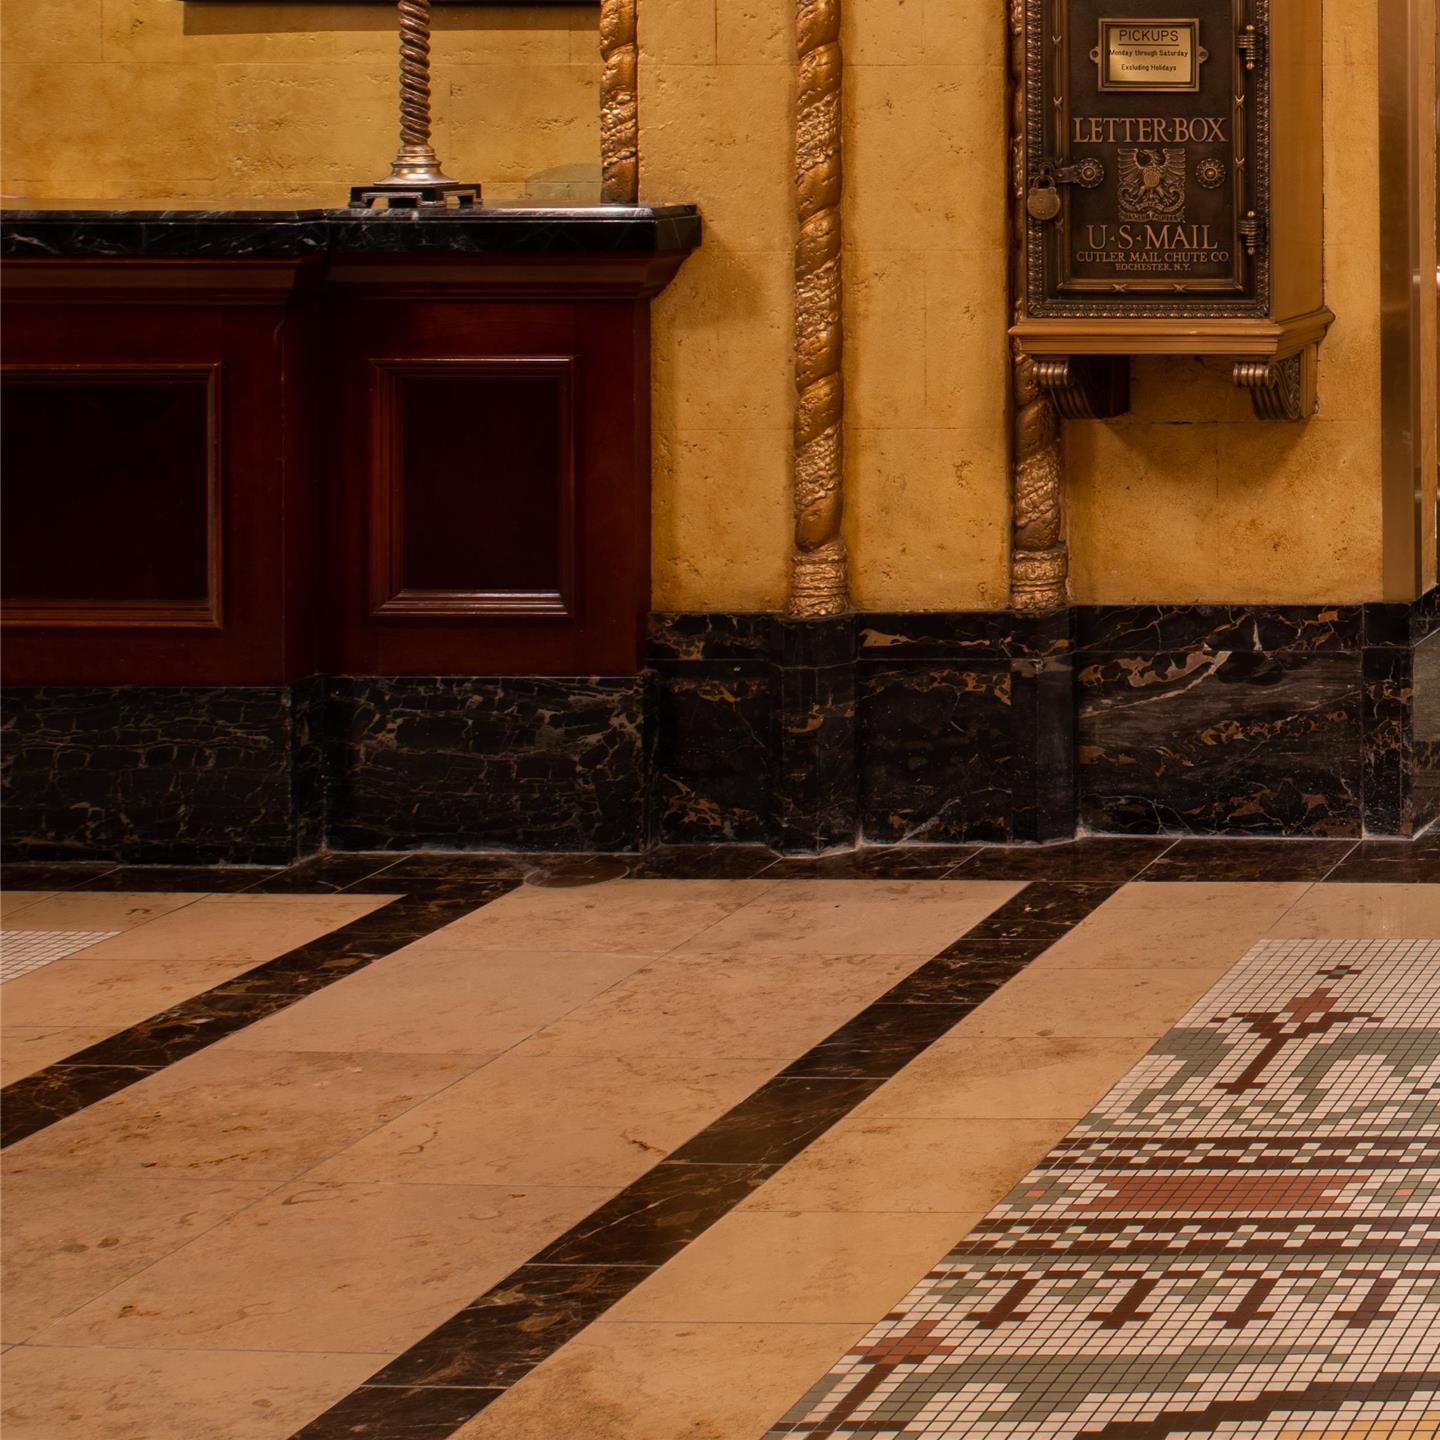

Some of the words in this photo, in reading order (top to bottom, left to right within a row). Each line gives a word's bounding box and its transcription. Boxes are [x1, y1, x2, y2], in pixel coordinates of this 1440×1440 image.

[1119, 29, 1179, 42] PICKUPS
[1110, 49, 1133, 57] Monday
[1134, 49, 1158, 57] through
[1159, 49, 1188, 57] Saturday
[1121, 63, 1149, 72] Excluding
[1076, 251, 1126, 262] CUTLER
[1130, 251, 1158, 262] MAIL
[1160, 251, 1208, 262] CHUTE
